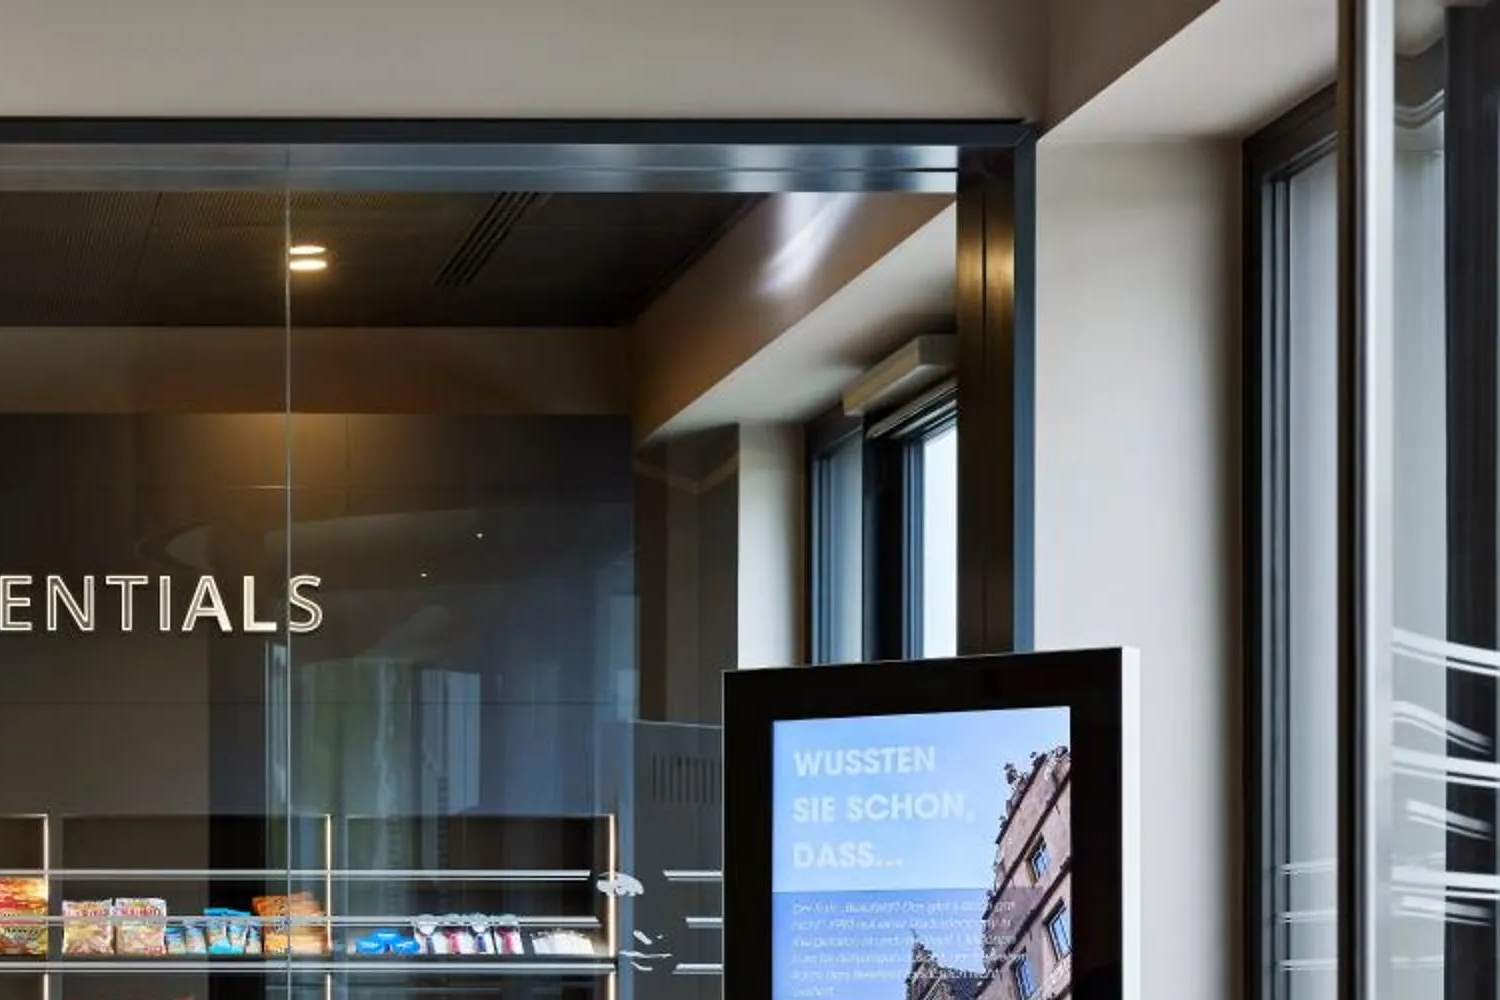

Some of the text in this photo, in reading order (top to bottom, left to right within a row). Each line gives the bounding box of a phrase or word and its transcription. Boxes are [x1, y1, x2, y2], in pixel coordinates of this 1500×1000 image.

[793, 745, 936, 777] WUSSTEN
[792, 792, 976, 823] SIE SCHON,
[792, 841, 904, 869] DASS...
